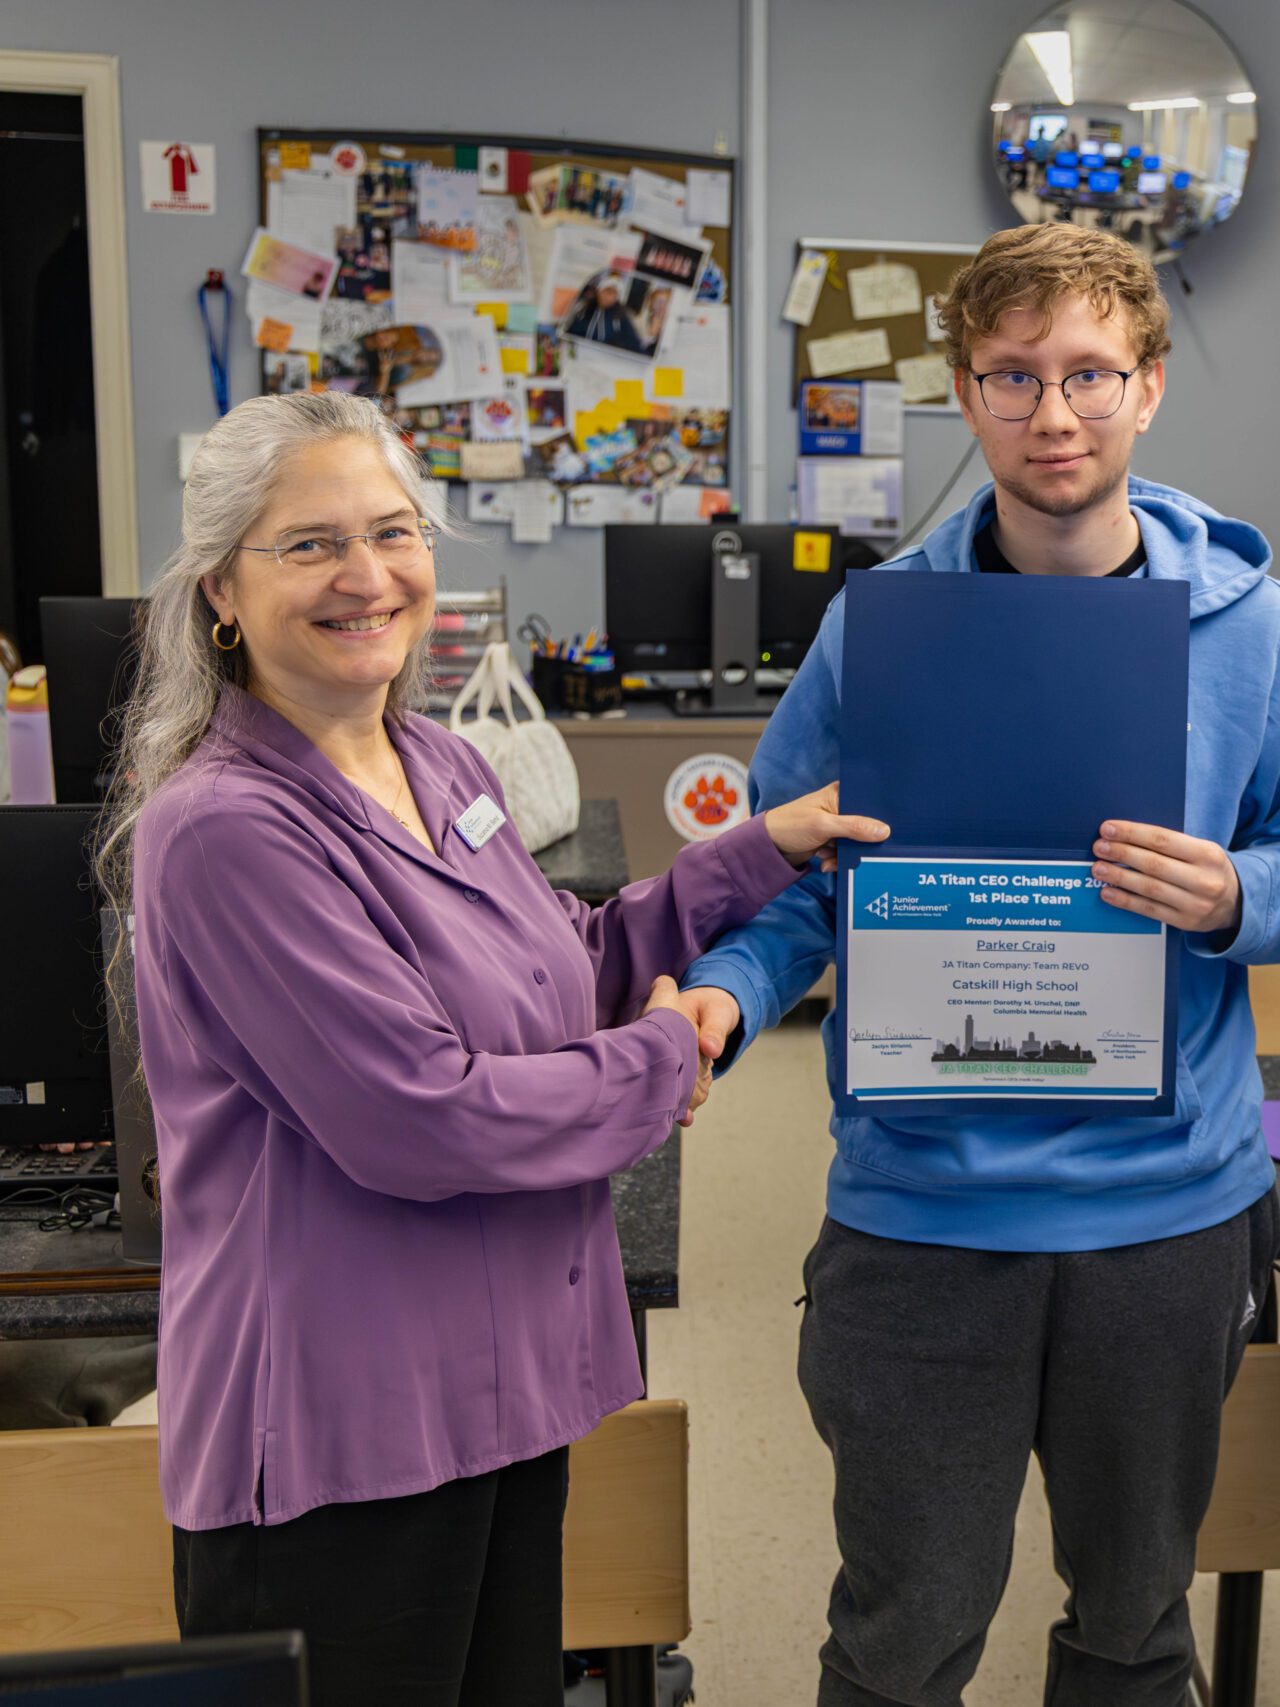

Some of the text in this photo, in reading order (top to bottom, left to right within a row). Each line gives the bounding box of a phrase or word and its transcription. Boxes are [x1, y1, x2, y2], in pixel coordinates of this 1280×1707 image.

[918, 874, 937, 885] JA
[940, 873, 976, 886] Titan
[979, 875, 1008, 886] CEO
[1012, 876, 1082, 890] Challenge
[892, 896, 919, 904] Junior
[968, 892, 1071, 905] 1st Place Team
[966, 917, 1061, 927] Proudly Awarded to:
[976, 940, 1056, 953] Parker Craig
[942, 960, 1089, 971] JA Titan Company: Team REVO
[952, 980, 1078, 992] Catskill High School
[993, 999, 1022, 1007] Dorothy
[957, 1063, 992, 1074] TITAN
[995, 1063, 1019, 1074] CEO
[1022, 1063, 1089, 1075] CHALLENGE
